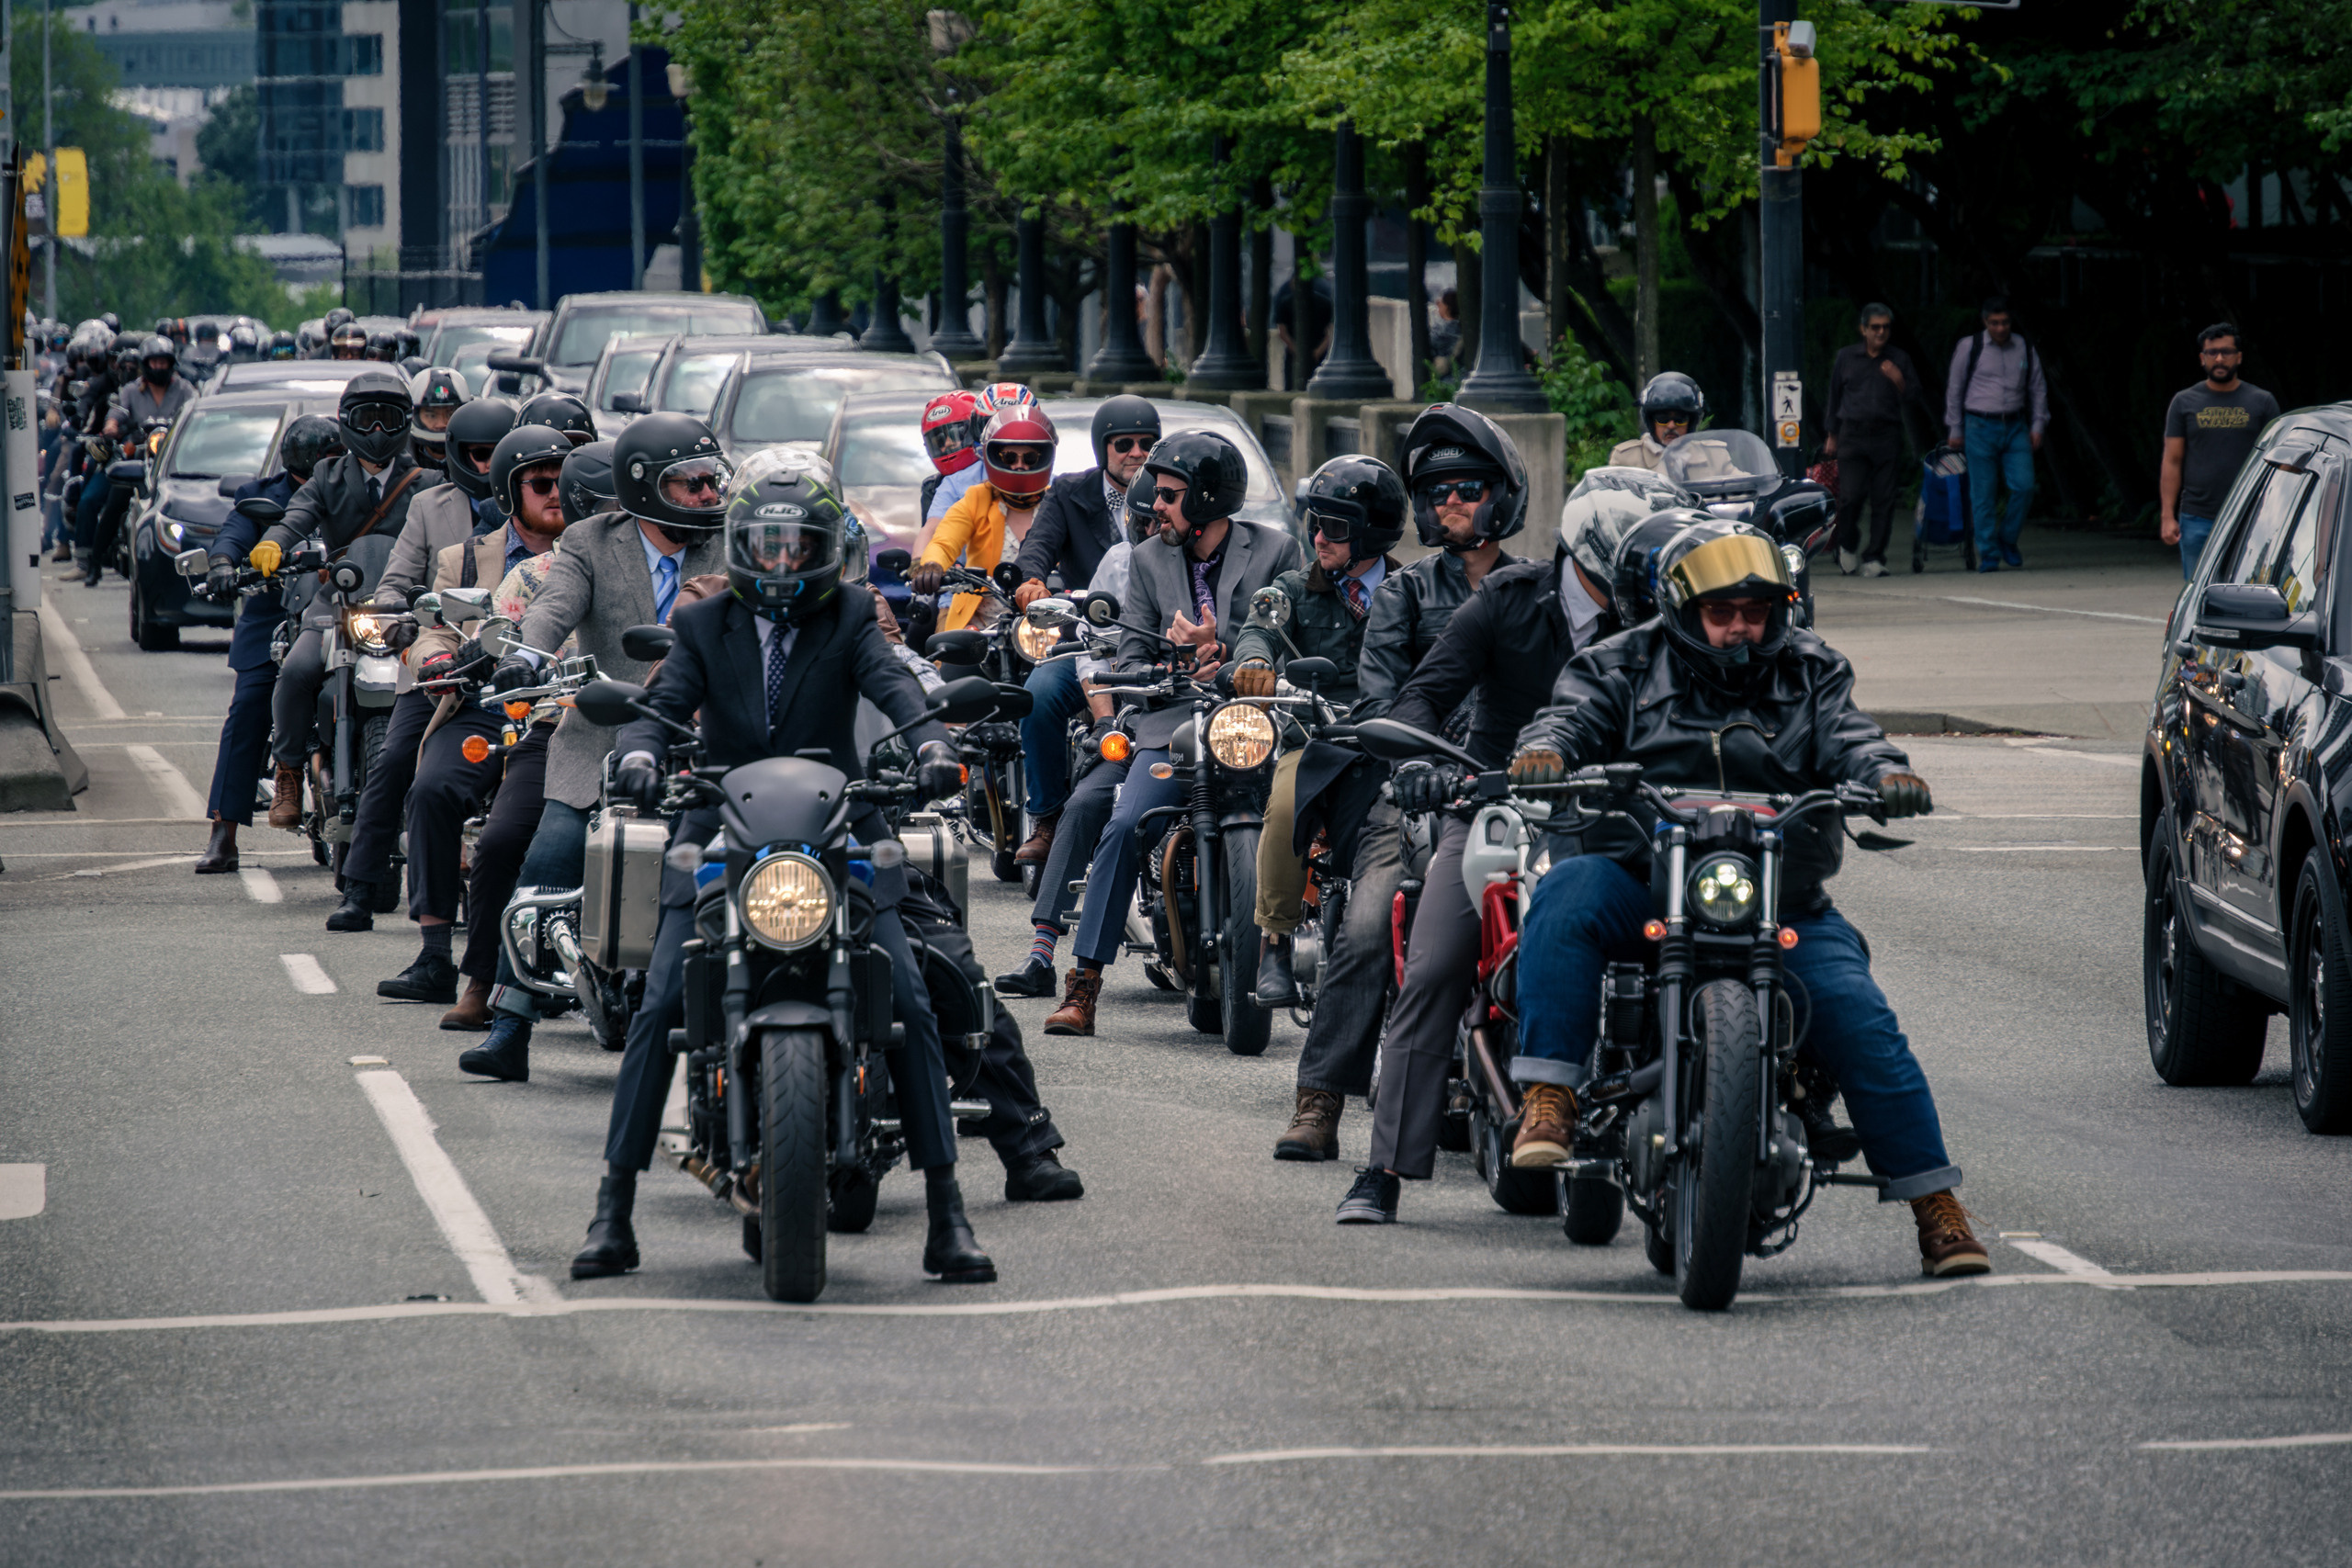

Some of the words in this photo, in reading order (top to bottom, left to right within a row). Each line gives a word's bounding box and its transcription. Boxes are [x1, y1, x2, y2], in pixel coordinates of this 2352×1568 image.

[992, 398, 1021, 408] Arai
[2197, 406, 2249, 417] STAR
[2197, 416, 2249, 428] WARS
[1431, 447, 1460, 458] SHOEI
[763, 506, 799, 514] HJC
